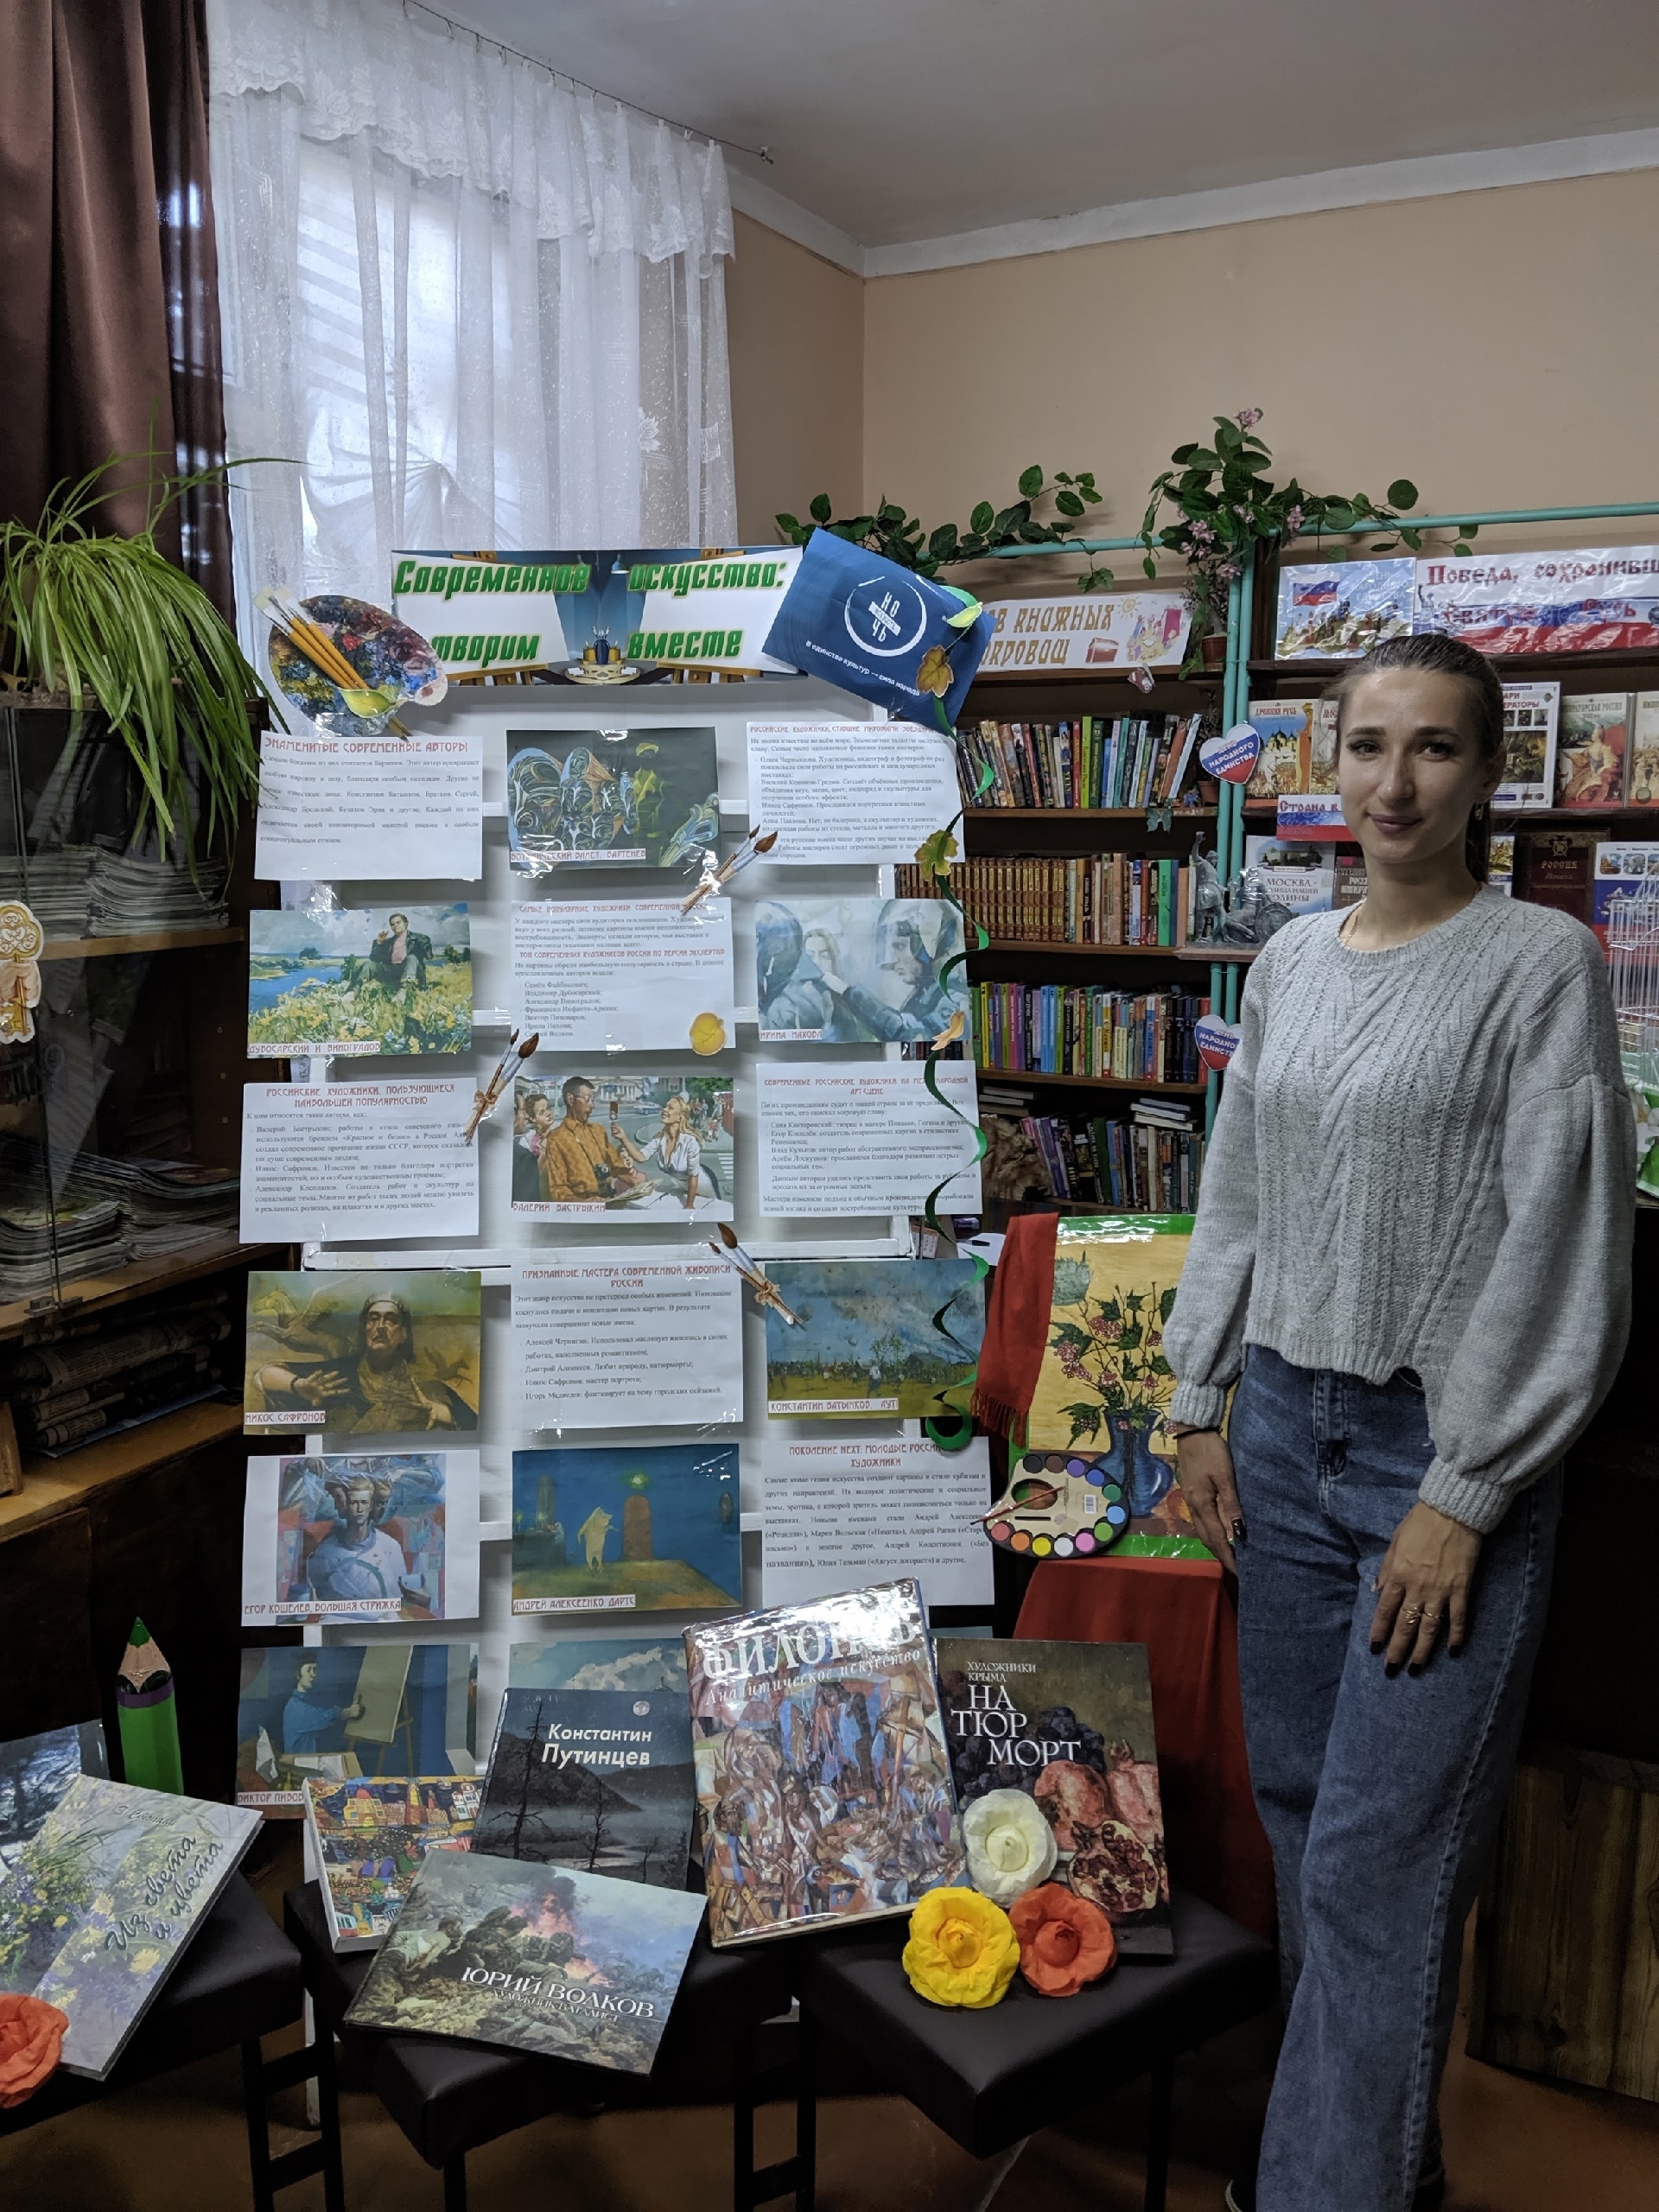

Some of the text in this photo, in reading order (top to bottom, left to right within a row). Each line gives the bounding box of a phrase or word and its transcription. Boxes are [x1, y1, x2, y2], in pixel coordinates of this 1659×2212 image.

[393, 560, 787, 601] Современное искусство:
[989, 604, 1114, 633] В КНИЖНЫХ
[432, 630, 743, 669] творим вместе
[842, 656, 870, 676] культур
[264, 737, 467, 753] ЗНАМЕНИТЫЕ СОВРЕМЕННЫЕ АВТОРЫ
[1216, 753, 1255, 774] ЕДИНСТВА
[511, 852, 572, 861] БОТИЧЕСКИЙ
[1266, 878, 1312, 887] МОСКВА
[266, 1084, 454, 1096] РОССИЙСКИЕ ХУДОЖНИКИ, ПОЛЬЗУЮЩИЕСЯ
[295, 1096, 428, 1109] НАИБОЛЬШЕЙ ПОПУЛЯРНОСТЬЮ
[522, 1264, 731, 1279] ПРИЗНАННЫЕ МАСТЕРА СОВРЕМЕННОЙ ЖИВОПИСИ
[611, 1279, 644, 1287] РОССИИ
[789, 1446, 838, 1456] ПОКОЛЕНИЕ
[841, 1445, 863, 1455] NEXT:
[866, 1444, 906, 1453] МОЛОДЫЕ
[851, 1458, 901, 1468] ХУДОЖНИКИ
[315, 1601, 357, 1612] БОЛЬШАЯ
[359, 1600, 401, 1611] СТРИЖКА
[702, 1620, 916, 1680] ФИЛОНВ
[967, 1662, 1036, 1673] ХУДОЖНИКИ
[705, 1666, 833, 1707] Аналитическое
[969, 1672, 1007, 1683] КРЫМА
[968, 1685, 1016, 1711] НА
[548, 1724, 652, 1742] Константин
[950, 1710, 1027, 1738] ТЮР
[542, 1743, 651, 1770] Путинцев
[987, 1738, 1082, 1766] МОРТ
[461, 1966, 655, 2018] ЮРИЙ ВОЛКОВ
